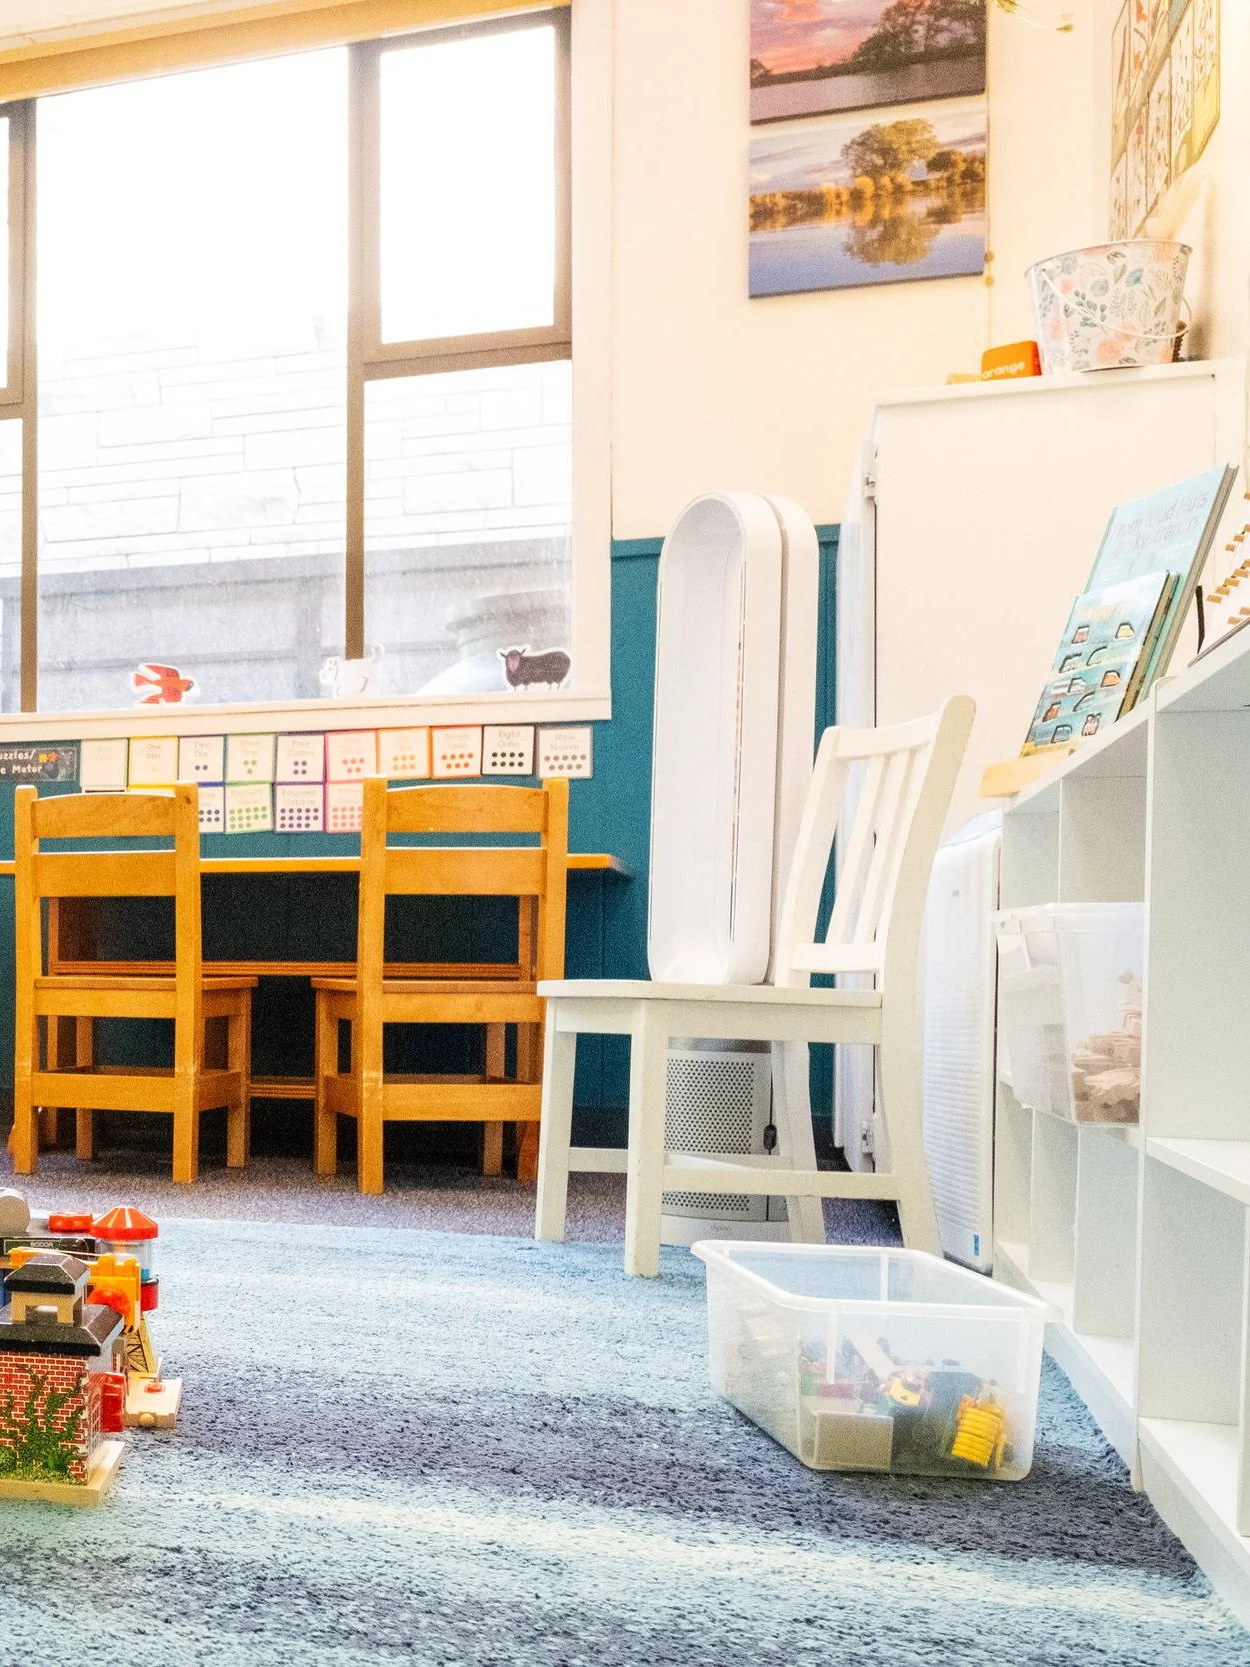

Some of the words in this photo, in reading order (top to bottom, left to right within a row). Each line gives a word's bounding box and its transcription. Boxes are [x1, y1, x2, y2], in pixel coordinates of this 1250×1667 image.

[981, 361, 1026, 380] orange
[498, 730, 520, 740] Eight
[12, 764, 43, 774] Motor
